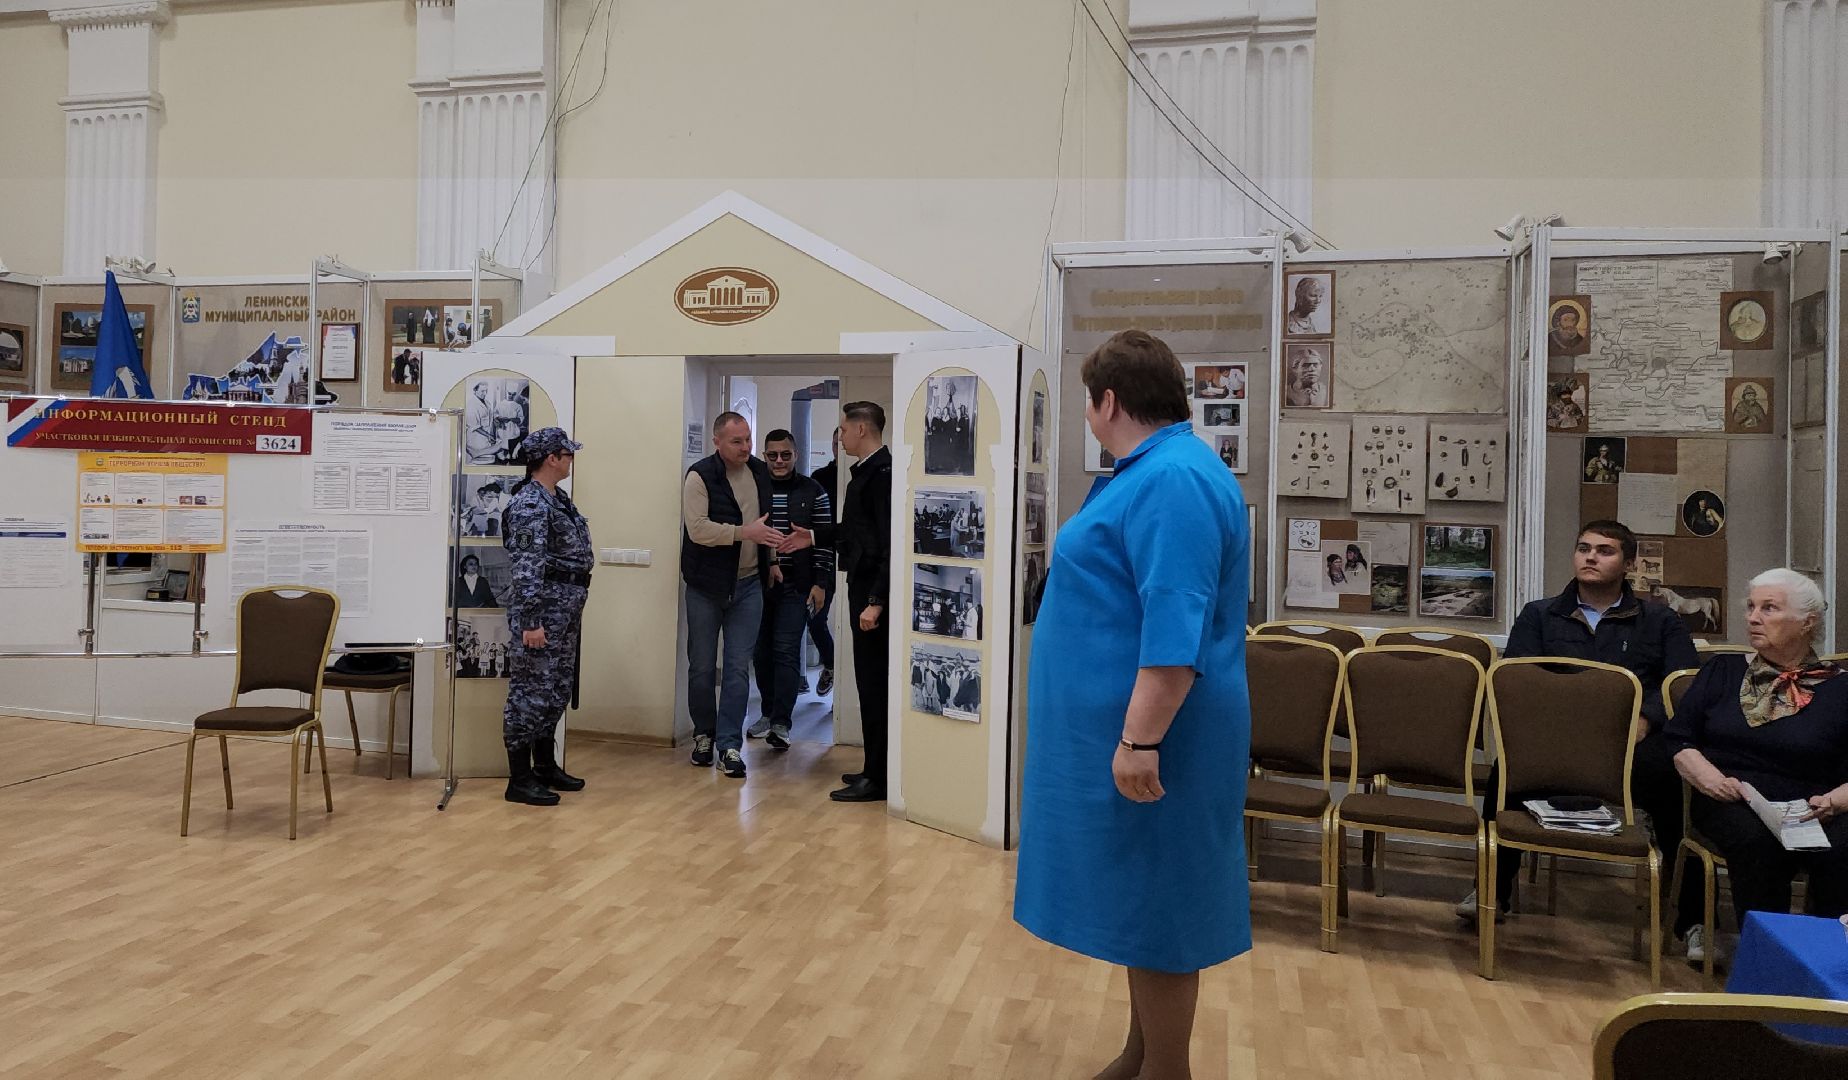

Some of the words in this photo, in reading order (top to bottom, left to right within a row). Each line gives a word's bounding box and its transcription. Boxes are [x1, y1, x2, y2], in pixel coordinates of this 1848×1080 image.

[245, 296, 310, 307] ЛЕНИНСКИ
[317, 307, 356, 321] РАЙОН
[35, 408, 218, 424] ИНФОРМАЦИОННЫЙ
[230, 415, 287, 427] СТЕНД
[35, 432, 99, 441] УЧАСТКОВАЯ
[102, 434, 185, 444] ИЗБИРАТЕЛЬНАЯ
[189, 437, 242, 446] КОМИССИЯ
[261, 437, 296, 450] 3624
